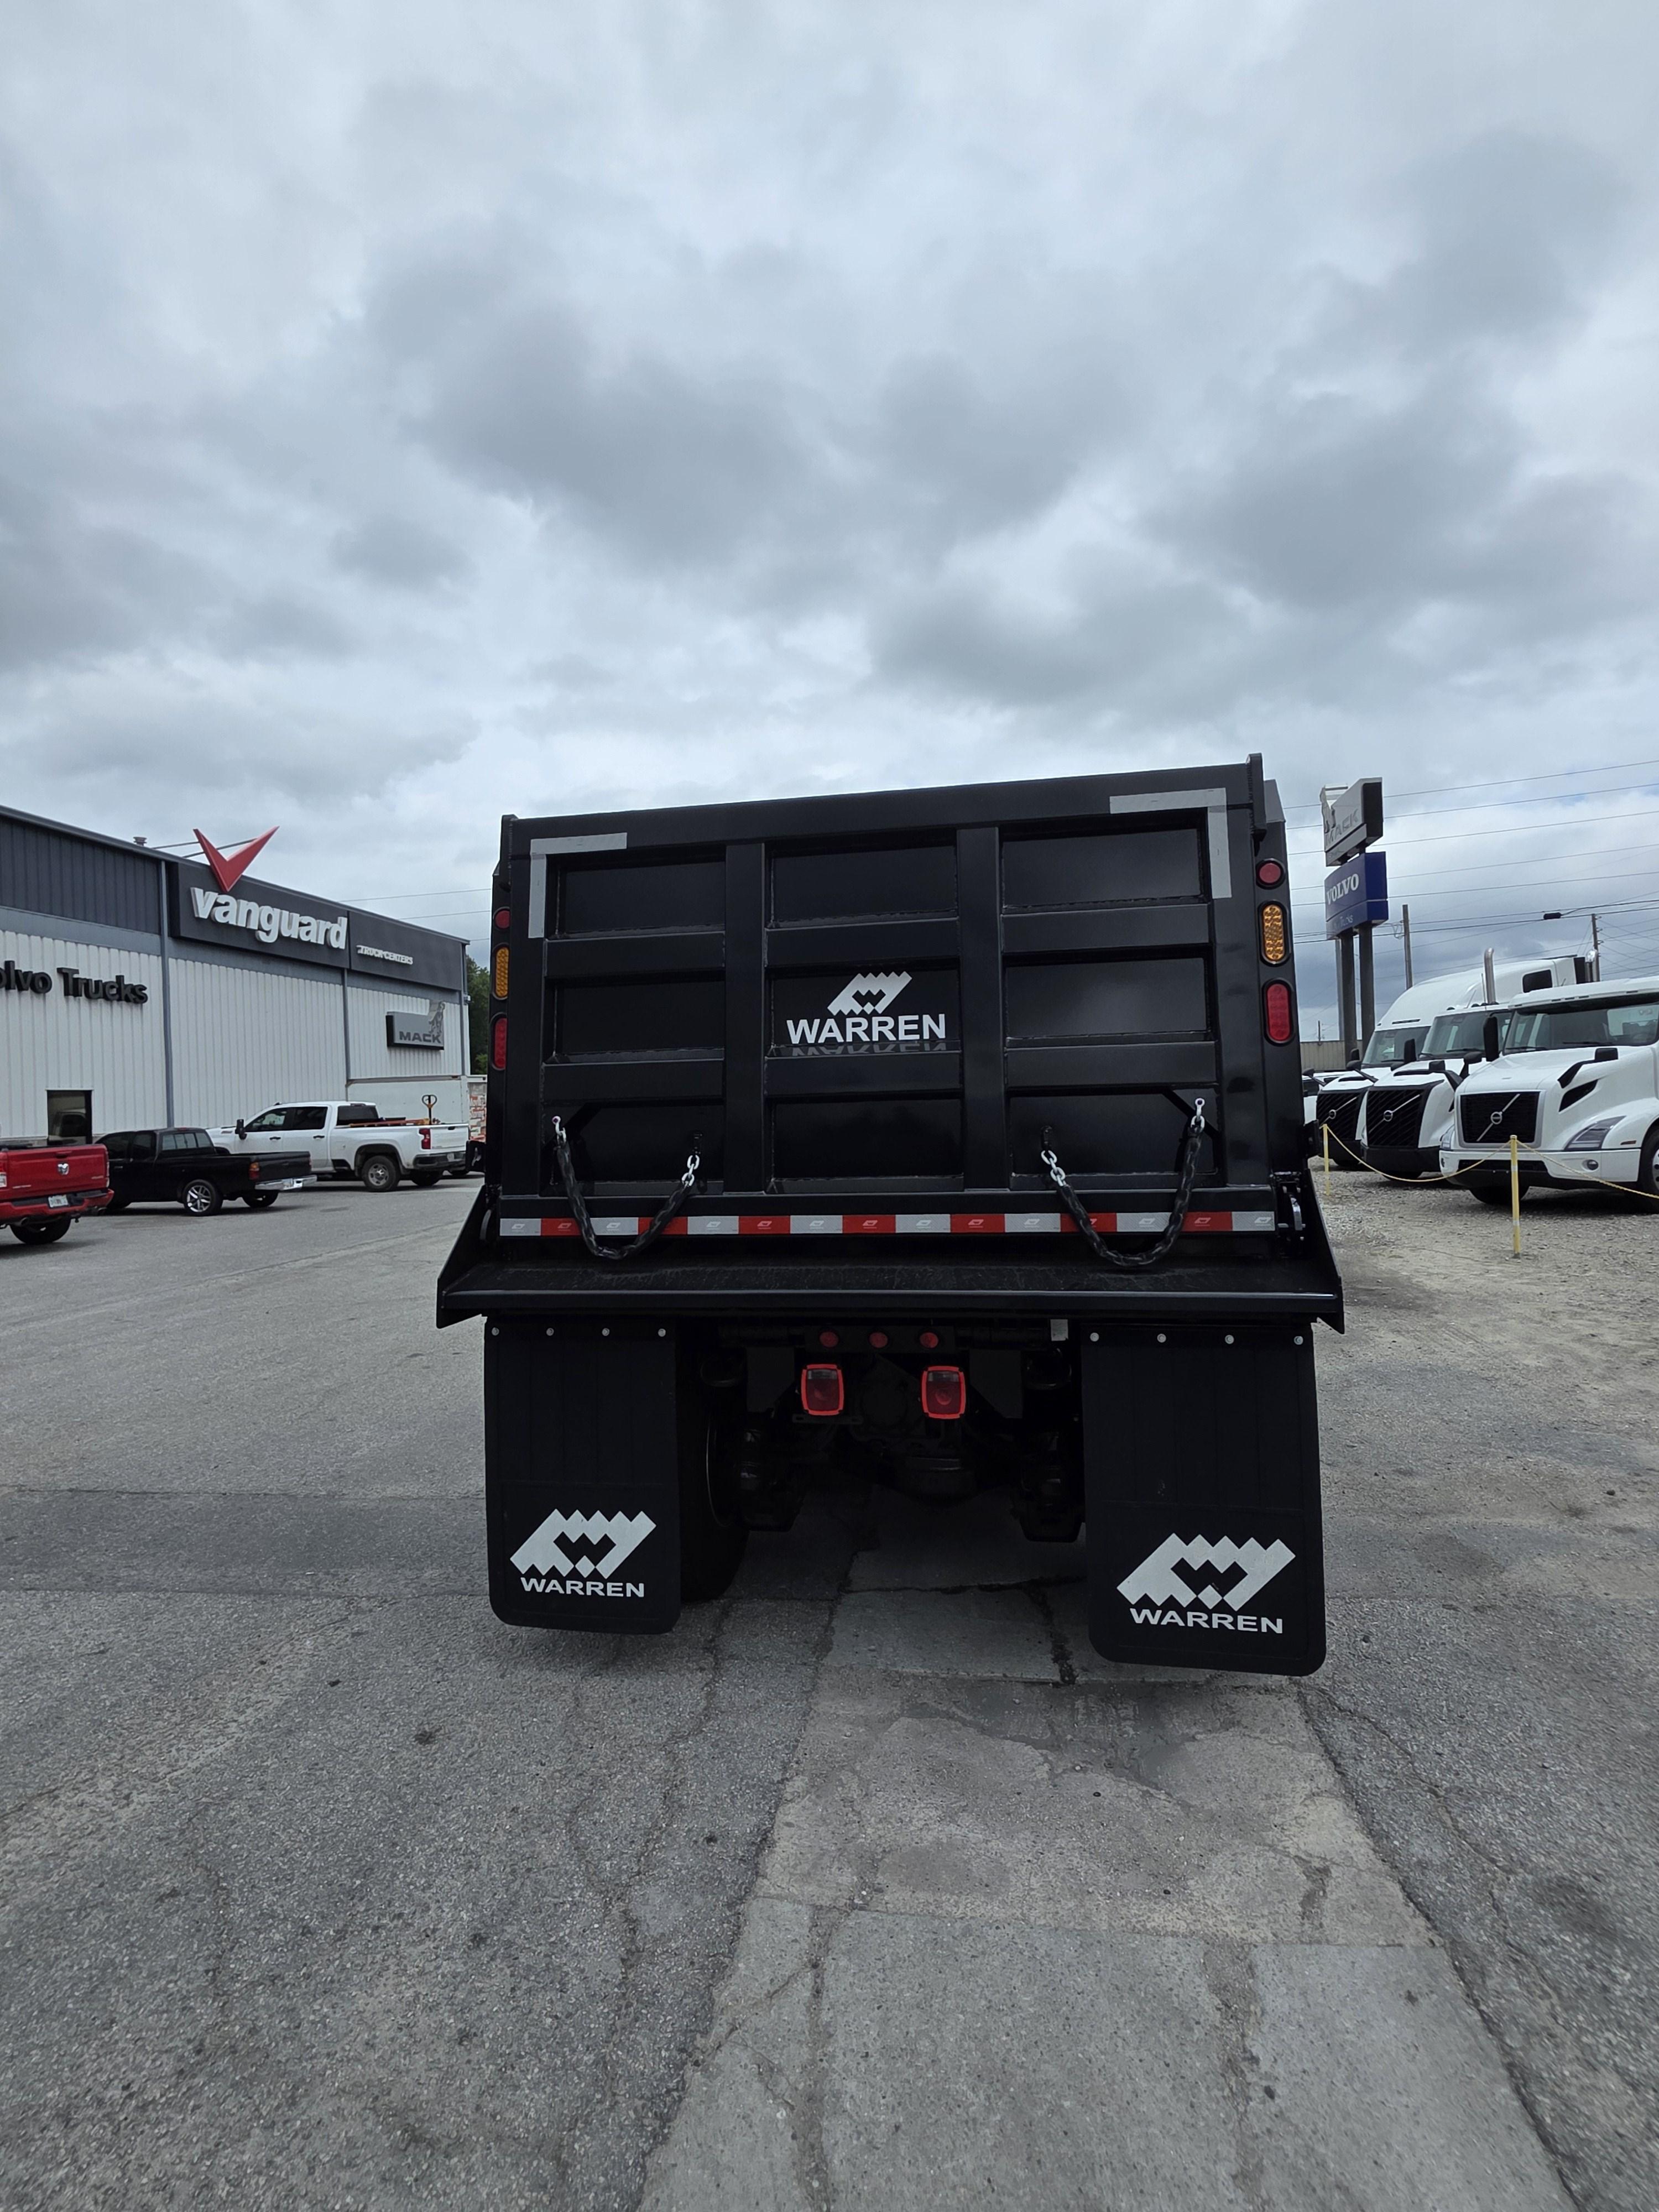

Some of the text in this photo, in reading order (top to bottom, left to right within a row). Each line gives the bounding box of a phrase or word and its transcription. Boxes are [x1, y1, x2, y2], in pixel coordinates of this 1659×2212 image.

[1327, 873, 1359, 905] VOLVO
[190, 887, 347, 950] vanguard
[356, 945, 413, 965] TRUCK CENTERS
[56, 967, 148, 1004] Trucks
[399, 1031, 441, 1044] MACK
[786, 1014, 946, 1044] WARREN
[520, 1577, 644, 1597] WARREN
[1130, 1608, 1283, 1634] WARREN
